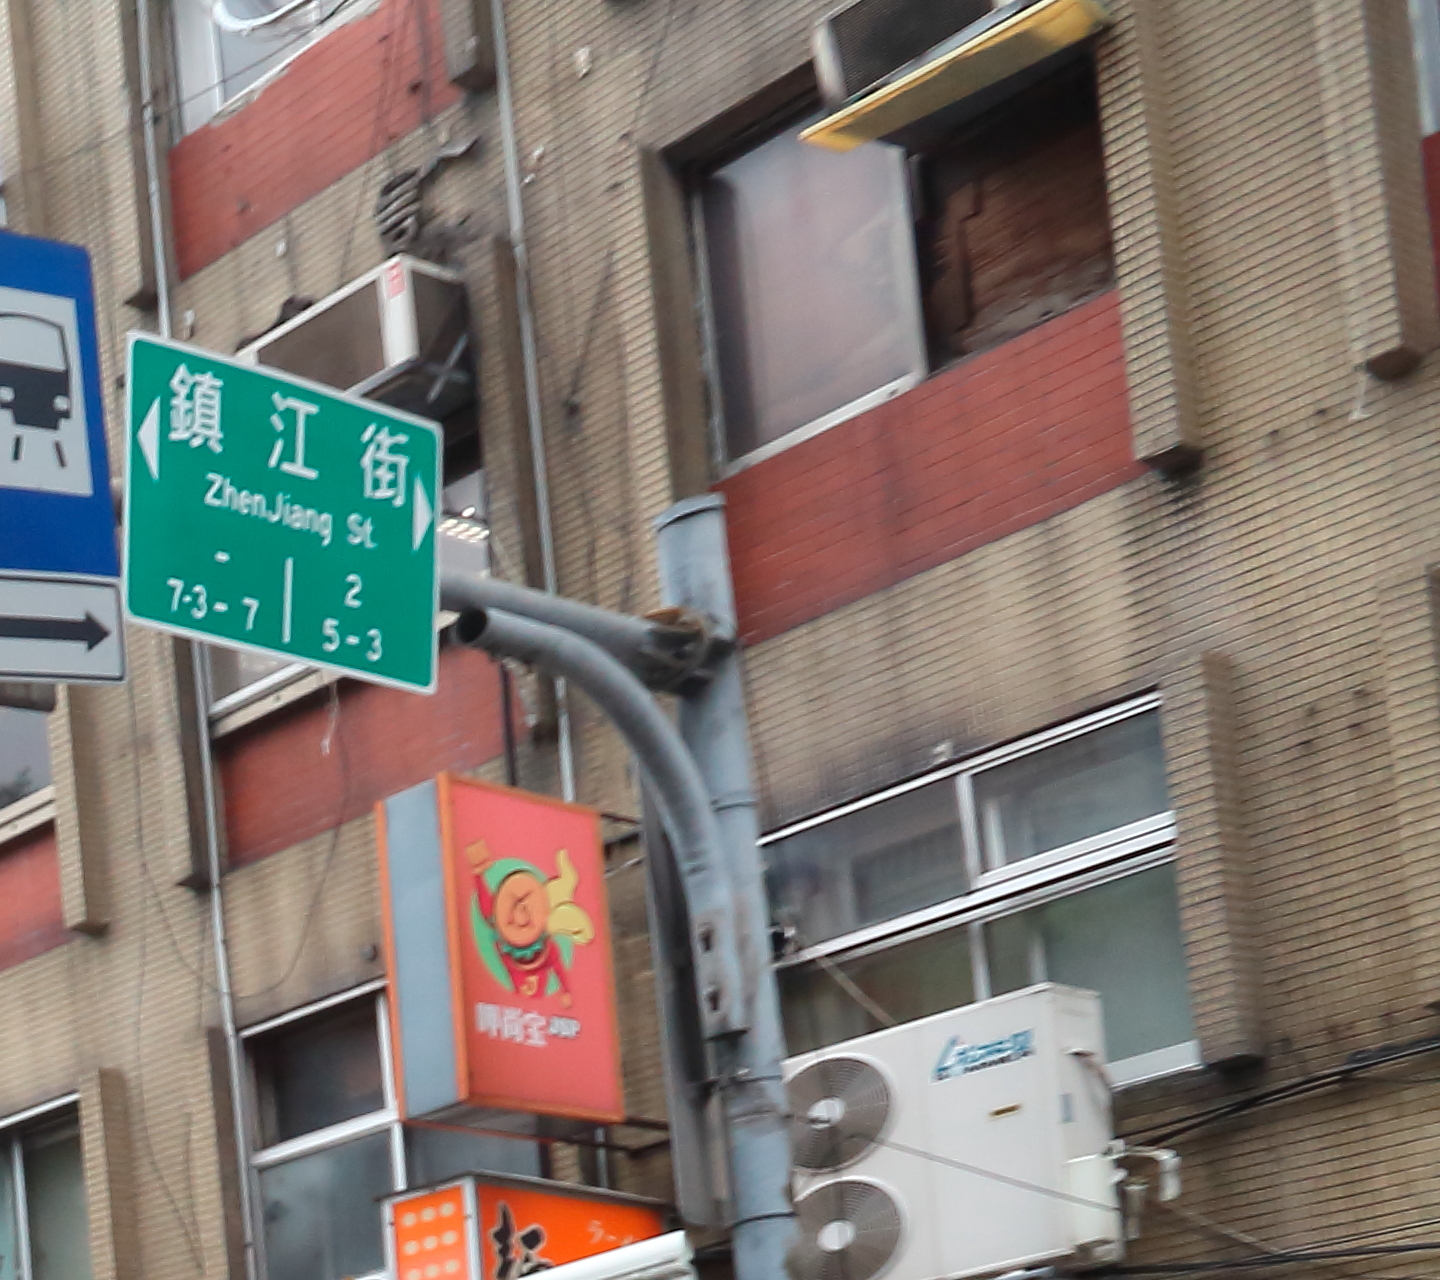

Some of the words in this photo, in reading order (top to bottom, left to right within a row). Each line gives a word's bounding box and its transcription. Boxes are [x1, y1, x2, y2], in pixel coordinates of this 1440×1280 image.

[168, 363, 409, 508] 鎮江街
[203, 472, 333, 547] ZhenJiang
[345, 512, 378, 548] St
[344, 573, 363, 609] 2
